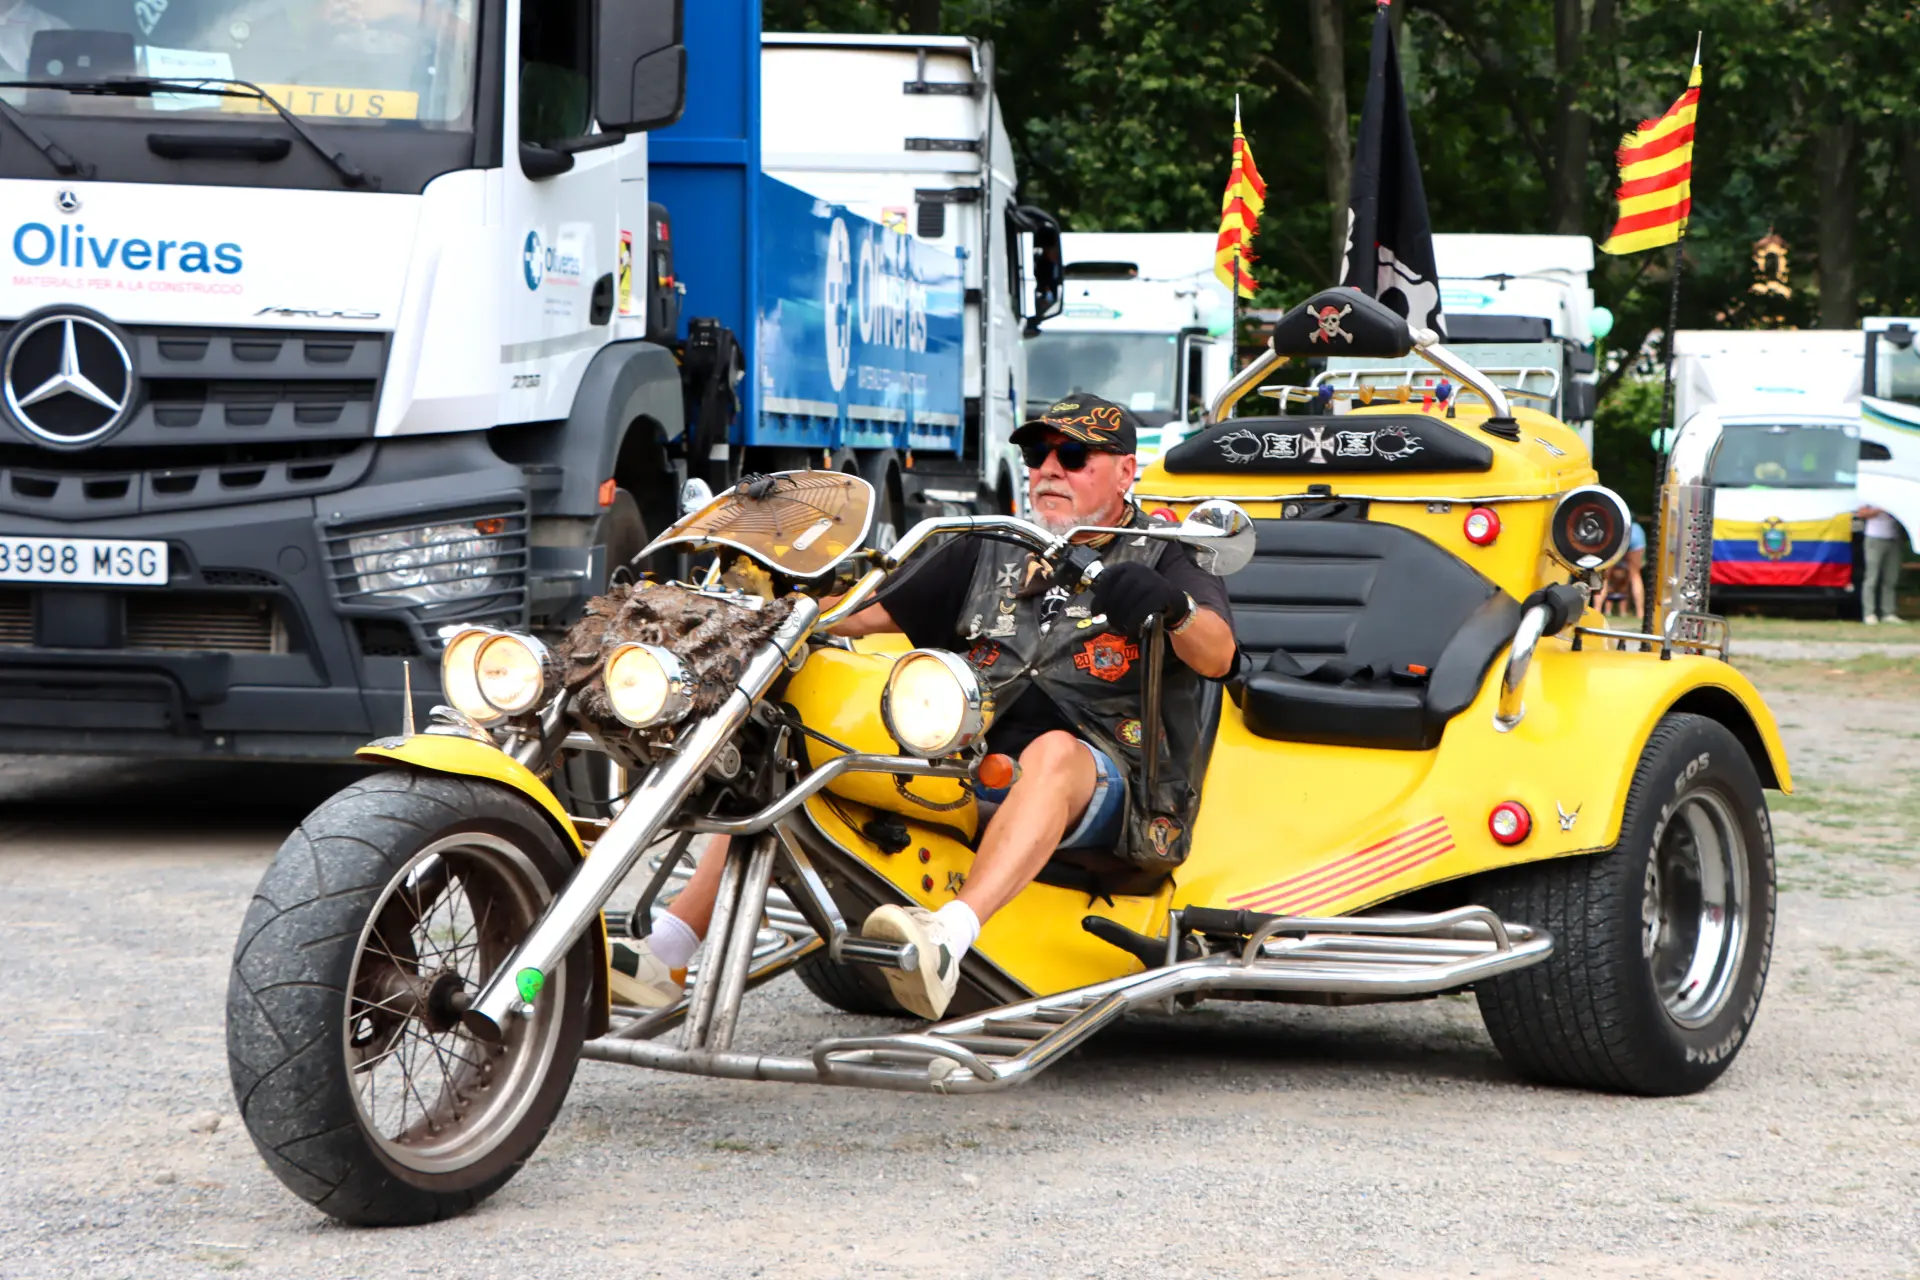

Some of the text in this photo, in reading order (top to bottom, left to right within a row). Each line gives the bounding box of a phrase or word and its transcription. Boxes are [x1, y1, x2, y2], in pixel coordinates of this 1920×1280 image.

[13, 222, 244, 275] Oliveras
[88, 279, 111, 290] PER
[128, 281, 144, 291] LA
[93, 546, 157, 577] MSG
